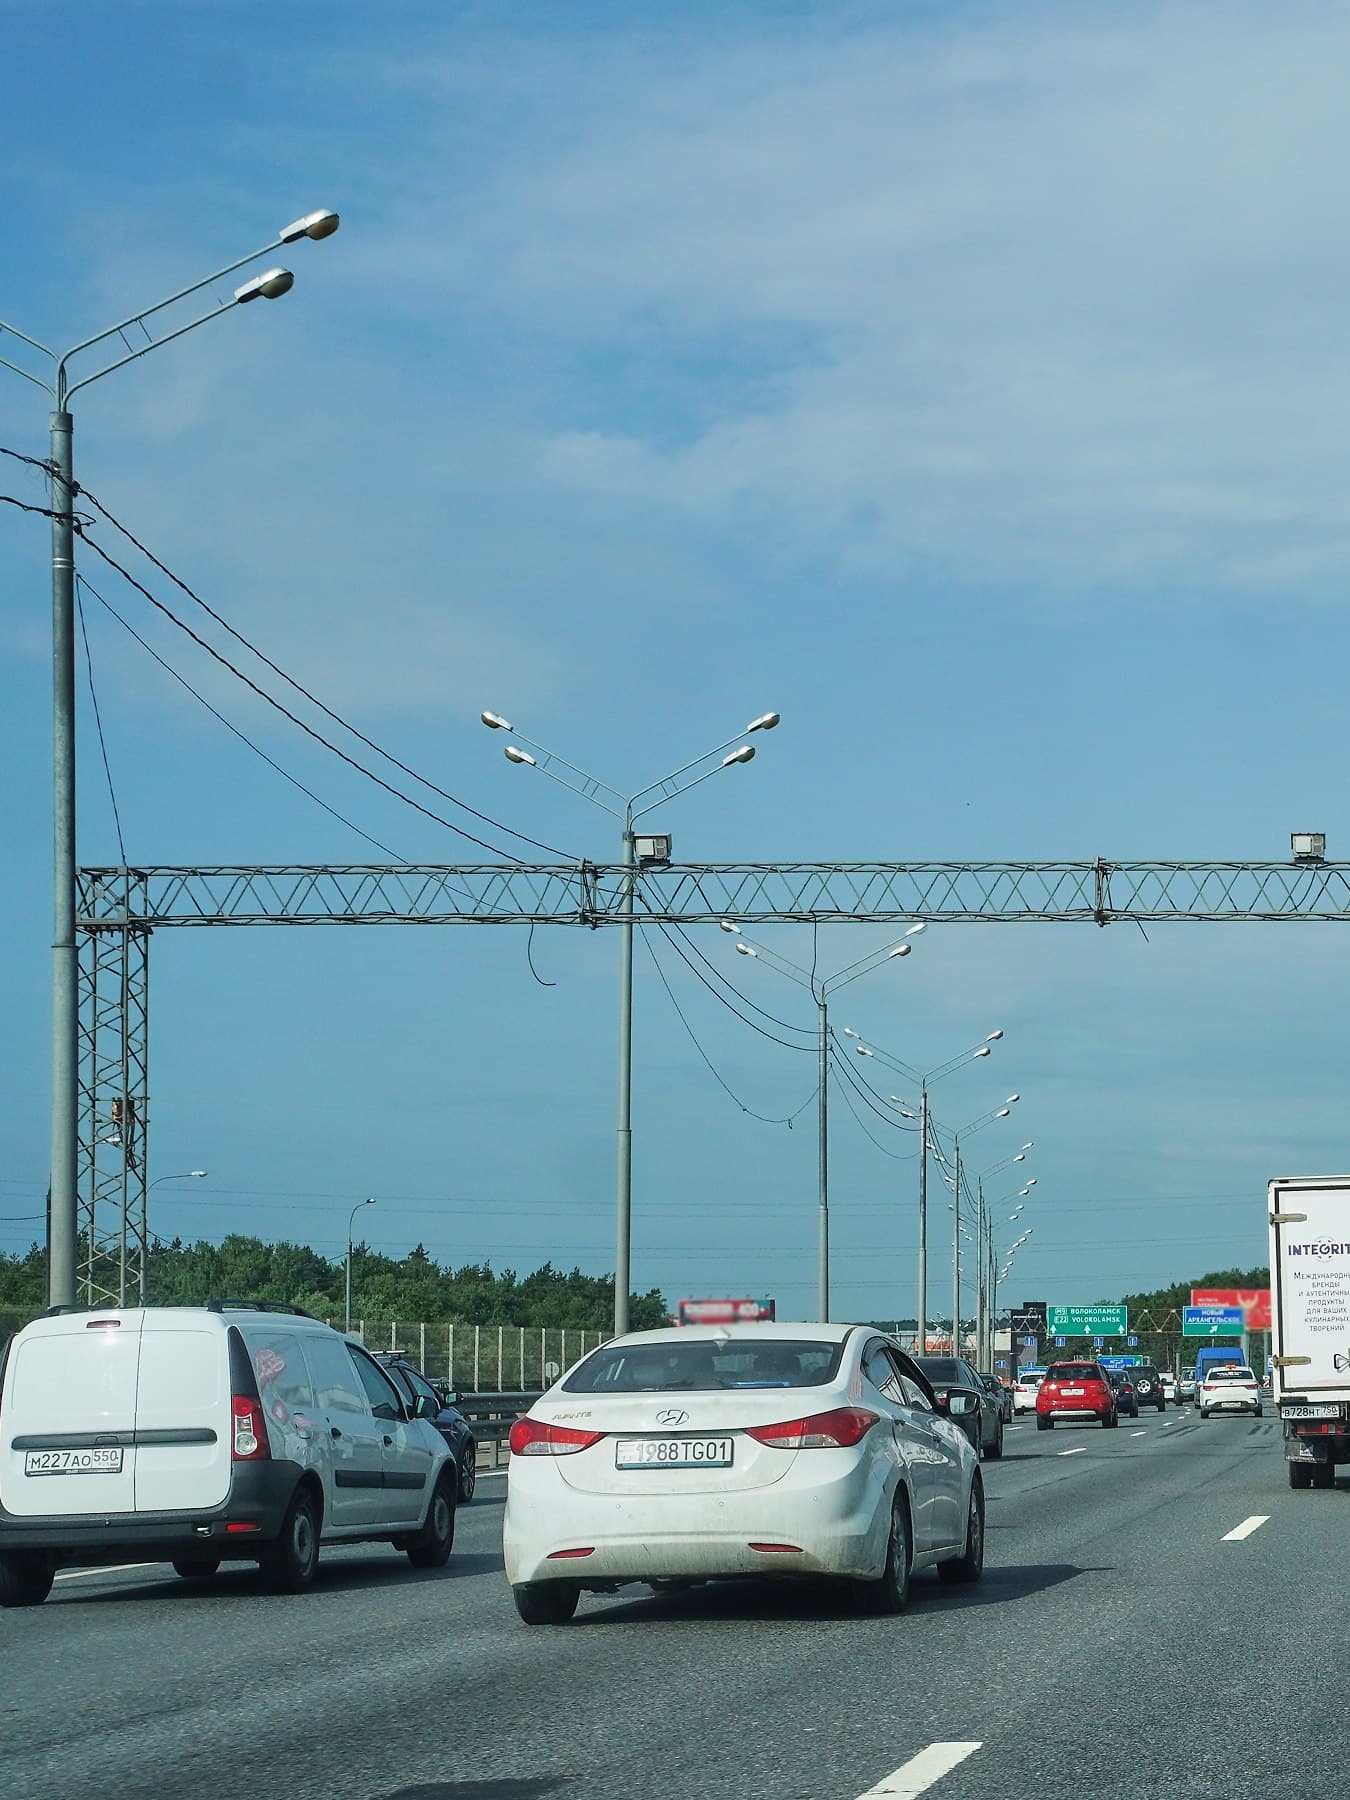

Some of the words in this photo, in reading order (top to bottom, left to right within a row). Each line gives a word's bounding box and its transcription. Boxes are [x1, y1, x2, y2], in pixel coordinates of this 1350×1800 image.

[1308, 1298, 1345, 1306] ПРОДУКТЫ
[1071, 1316, 1121, 1324] VOLOKOLAMSK
[1310, 1323, 1346, 1332] ТВОРЕНИЙ
